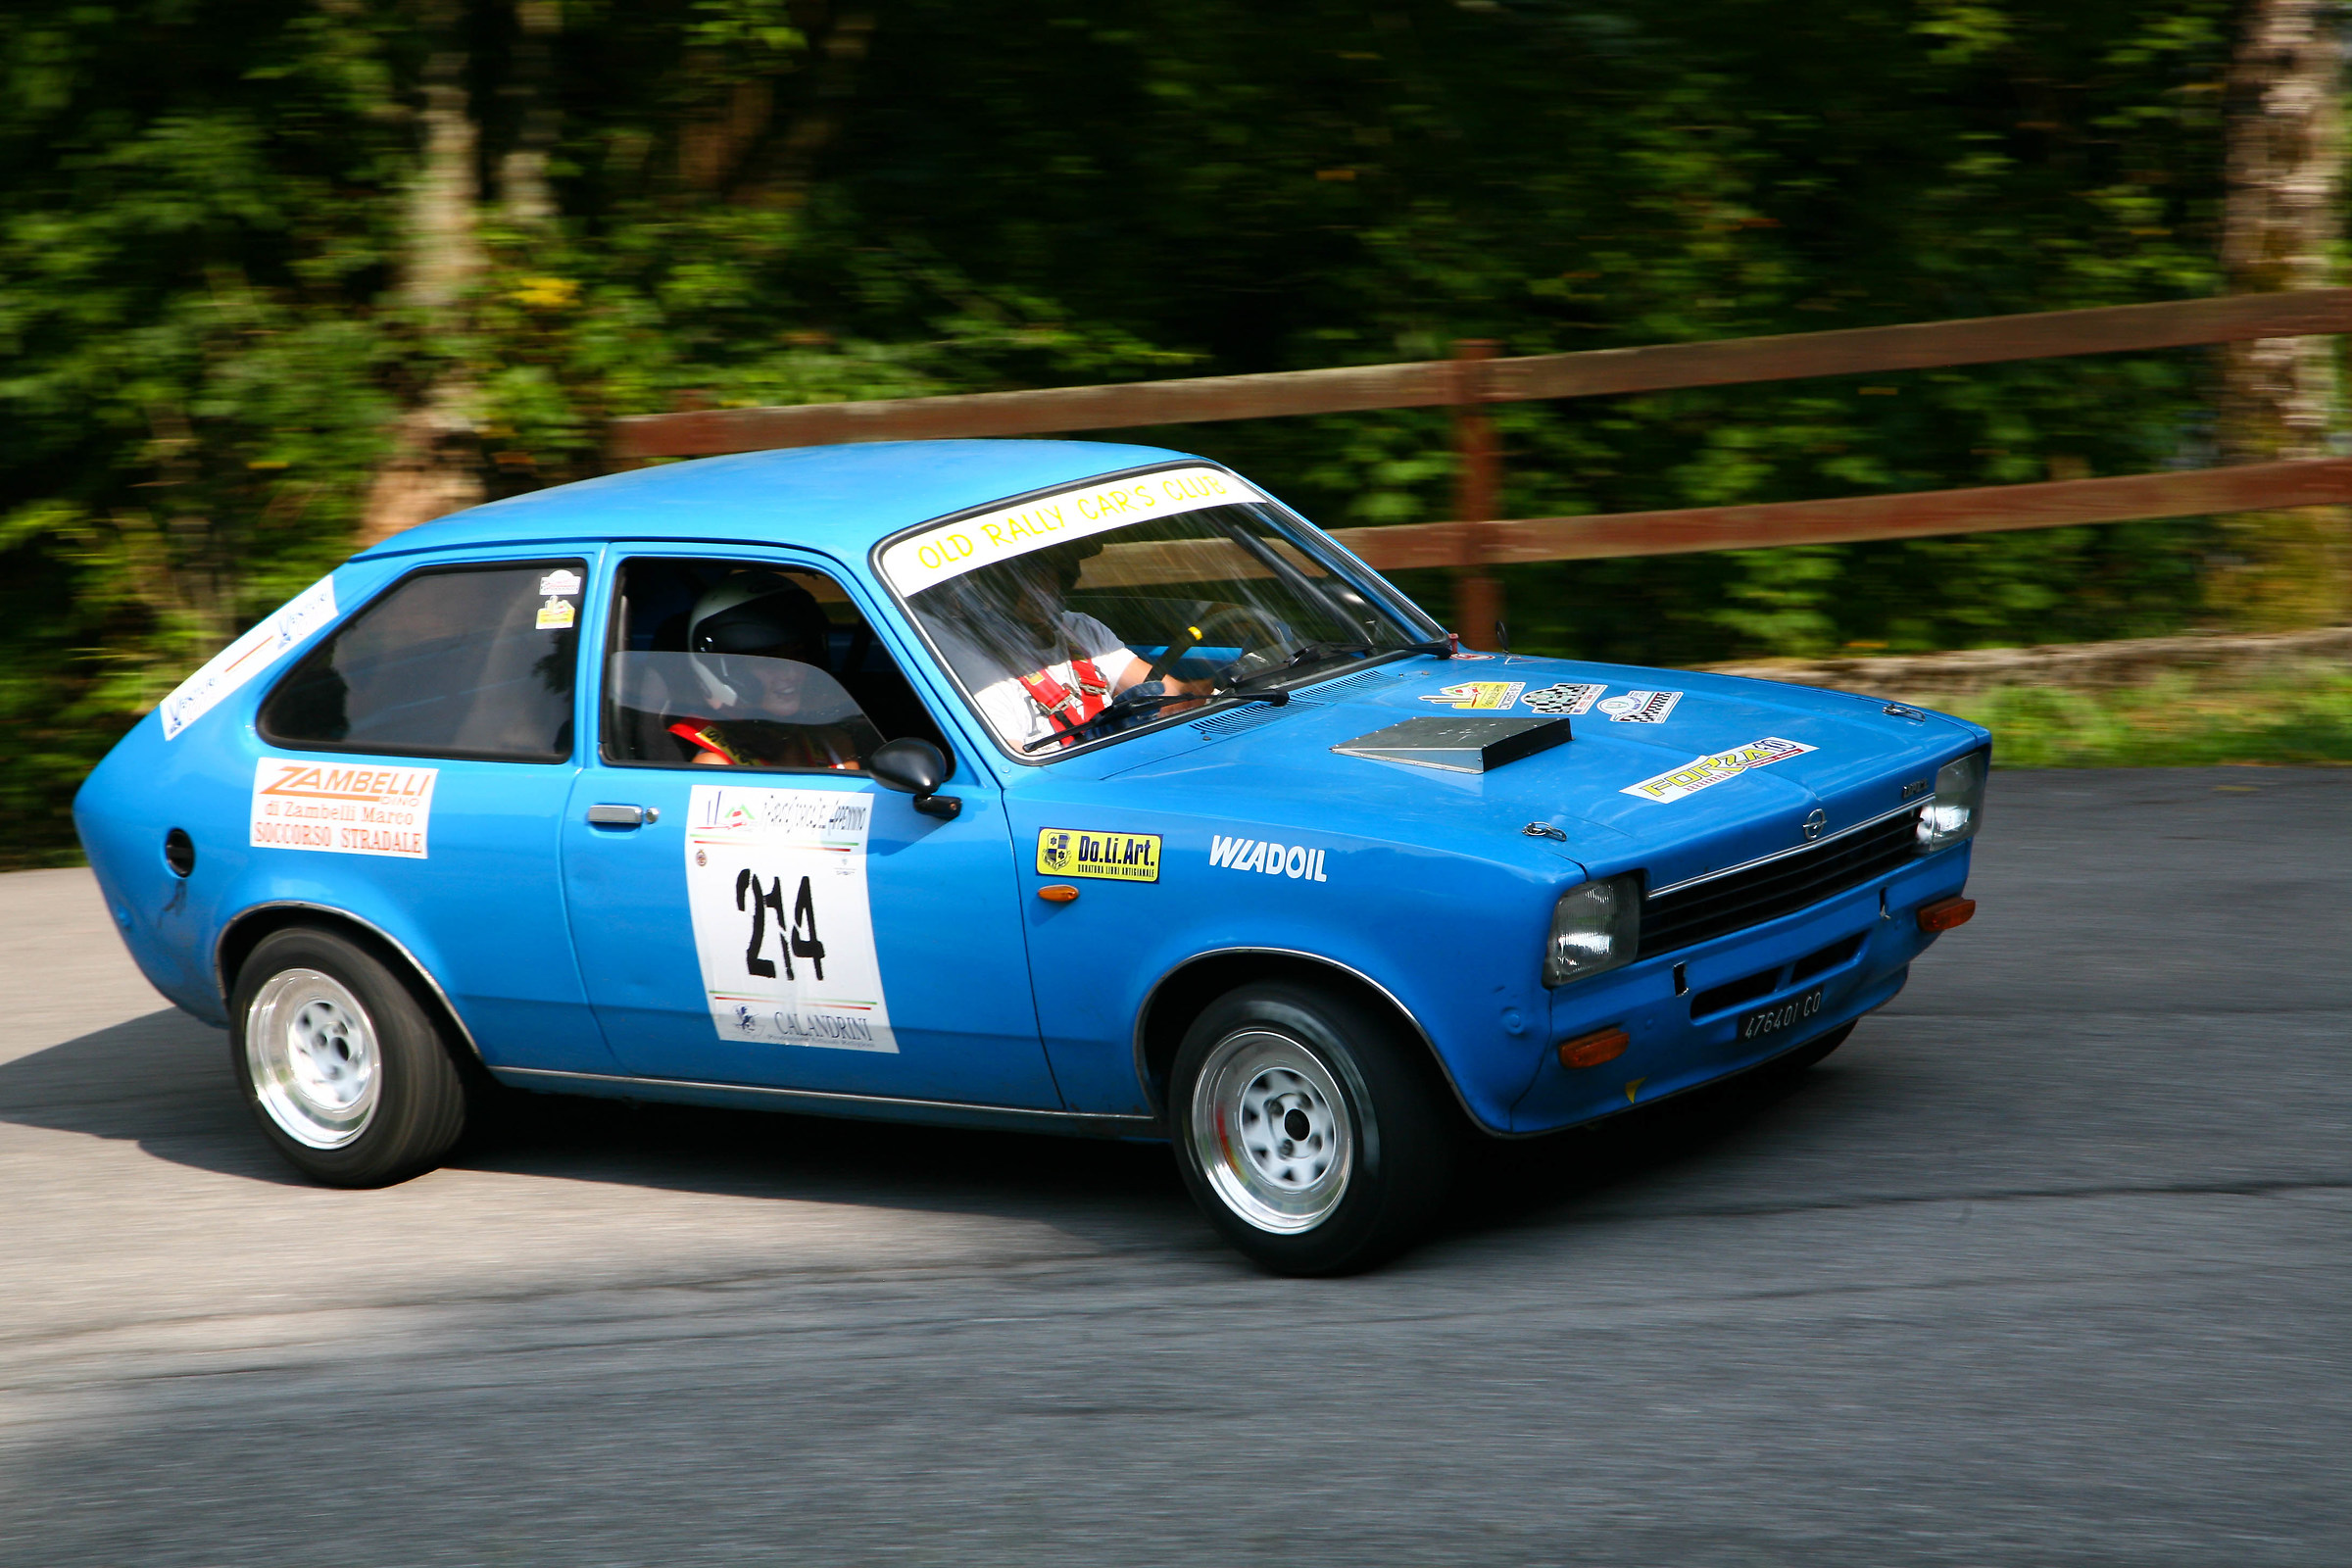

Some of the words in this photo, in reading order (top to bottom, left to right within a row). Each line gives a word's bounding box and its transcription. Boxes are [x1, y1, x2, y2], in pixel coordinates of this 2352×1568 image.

[917, 532, 974, 569] OLD
[981, 505, 1066, 548] RALLY
[1077, 484, 1156, 522] CAR'S
[1161, 474, 1228, 502] CLUB
[259, 765, 431, 803] ZAMBELLI
[265, 800, 280, 816] di
[283, 801, 356, 822] Zambelli
[361, 807, 415, 826] Marco
[254, 821, 332, 847] SOCCORSO
[340, 827, 423, 854] STRADALE
[1079, 835, 1155, 867] Do.Li.Art.
[1077, 862, 1104, 874] DORATURA
[1104, 865, 1120, 875] LIBRI
[1121, 866, 1155, 878] ARTIGIANALE
[736, 868, 826, 981] 214
[773, 1010, 873, 1043] CALANDRINI
[1744, 1002, 1799, 1039] 476401
[1803, 991, 1822, 1017] CO
